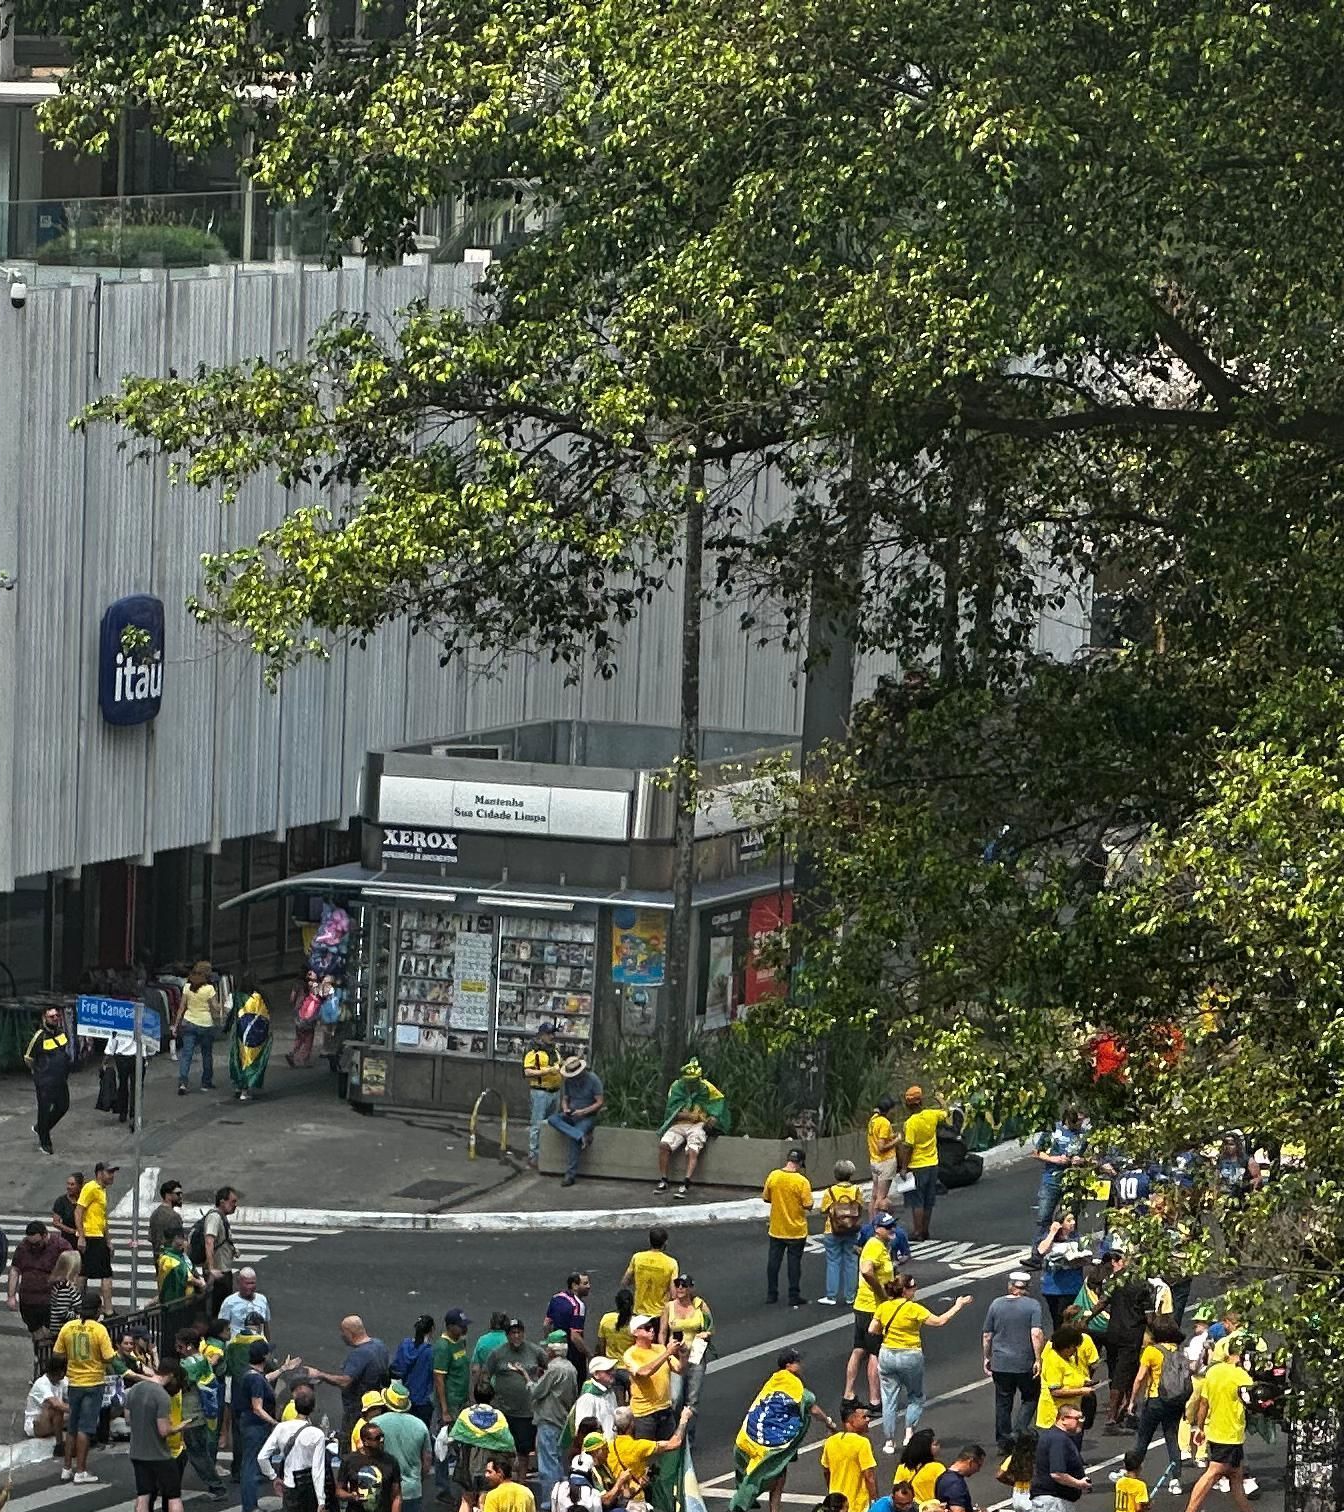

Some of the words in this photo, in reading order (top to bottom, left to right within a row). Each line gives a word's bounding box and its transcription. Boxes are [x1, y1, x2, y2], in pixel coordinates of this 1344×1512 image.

[114, 651, 164, 702] itaú
[474, 794, 524, 808] Mantenha
[454, 806, 474, 818] Sua
[476, 808, 512, 821] Cidade
[514, 811, 547, 823] Limpa
[383, 829, 458, 850] XEROX
[81, 1000, 99, 1014] Frei
